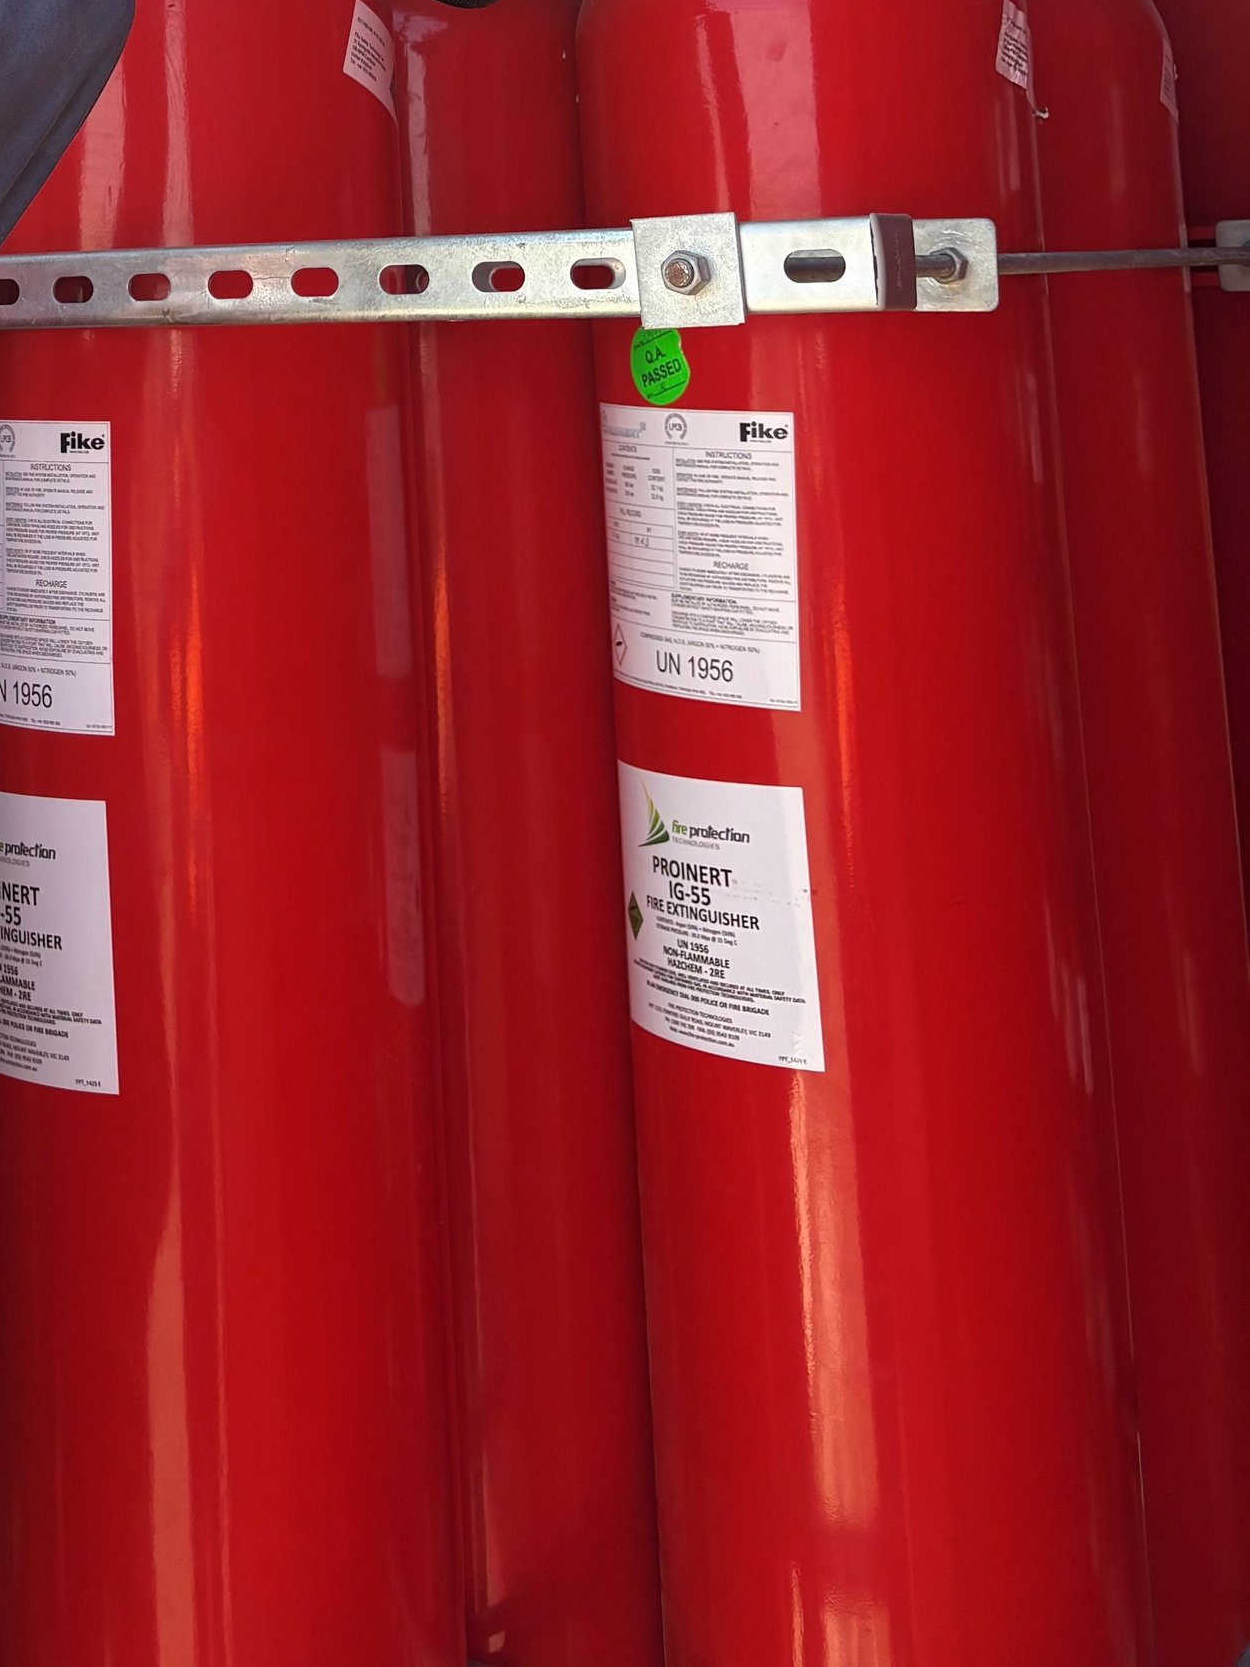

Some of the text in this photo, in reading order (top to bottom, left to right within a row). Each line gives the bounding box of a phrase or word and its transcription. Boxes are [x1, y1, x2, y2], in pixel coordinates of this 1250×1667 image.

[641, 358, 682, 388] PASSED
[60, 431, 105, 453] Fike
[739, 421, 788, 442] Fike
[705, 451, 752, 460] INSTRUCTIONS
[30, 463, 72, 472] INSTRUCTIONS
[713, 560, 749, 571] RECHARGE
[35, 579, 68, 589] RECHARGE
[656, 650, 734, 683] UN 1956
[12, 681, 53, 708] 1956
[671, 820, 751, 843] fire protection
[5, 841, 56, 860] protection
[671, 836, 721, 850] TECHNOLOGIES
[652, 855, 733, 888] PROINERT
[669, 880, 711, 906] IG-55
[646, 895, 760, 931] FIRE EXTINGUISHER
[662, 945, 730, 969] NON-FLAMMABLE
[676, 939, 709, 954] UN 1956
[3, 963, 19, 976] 1956
[667, 957, 703, 975] HAZCHEM
[709, 967, 726, 979] 2RE
[18, 990, 32, 1002] 2RE
[700, 996, 719, 1007] POLICE
[719, 1001, 728, 1009] OR
[728, 1003, 742, 1012] FIRE
